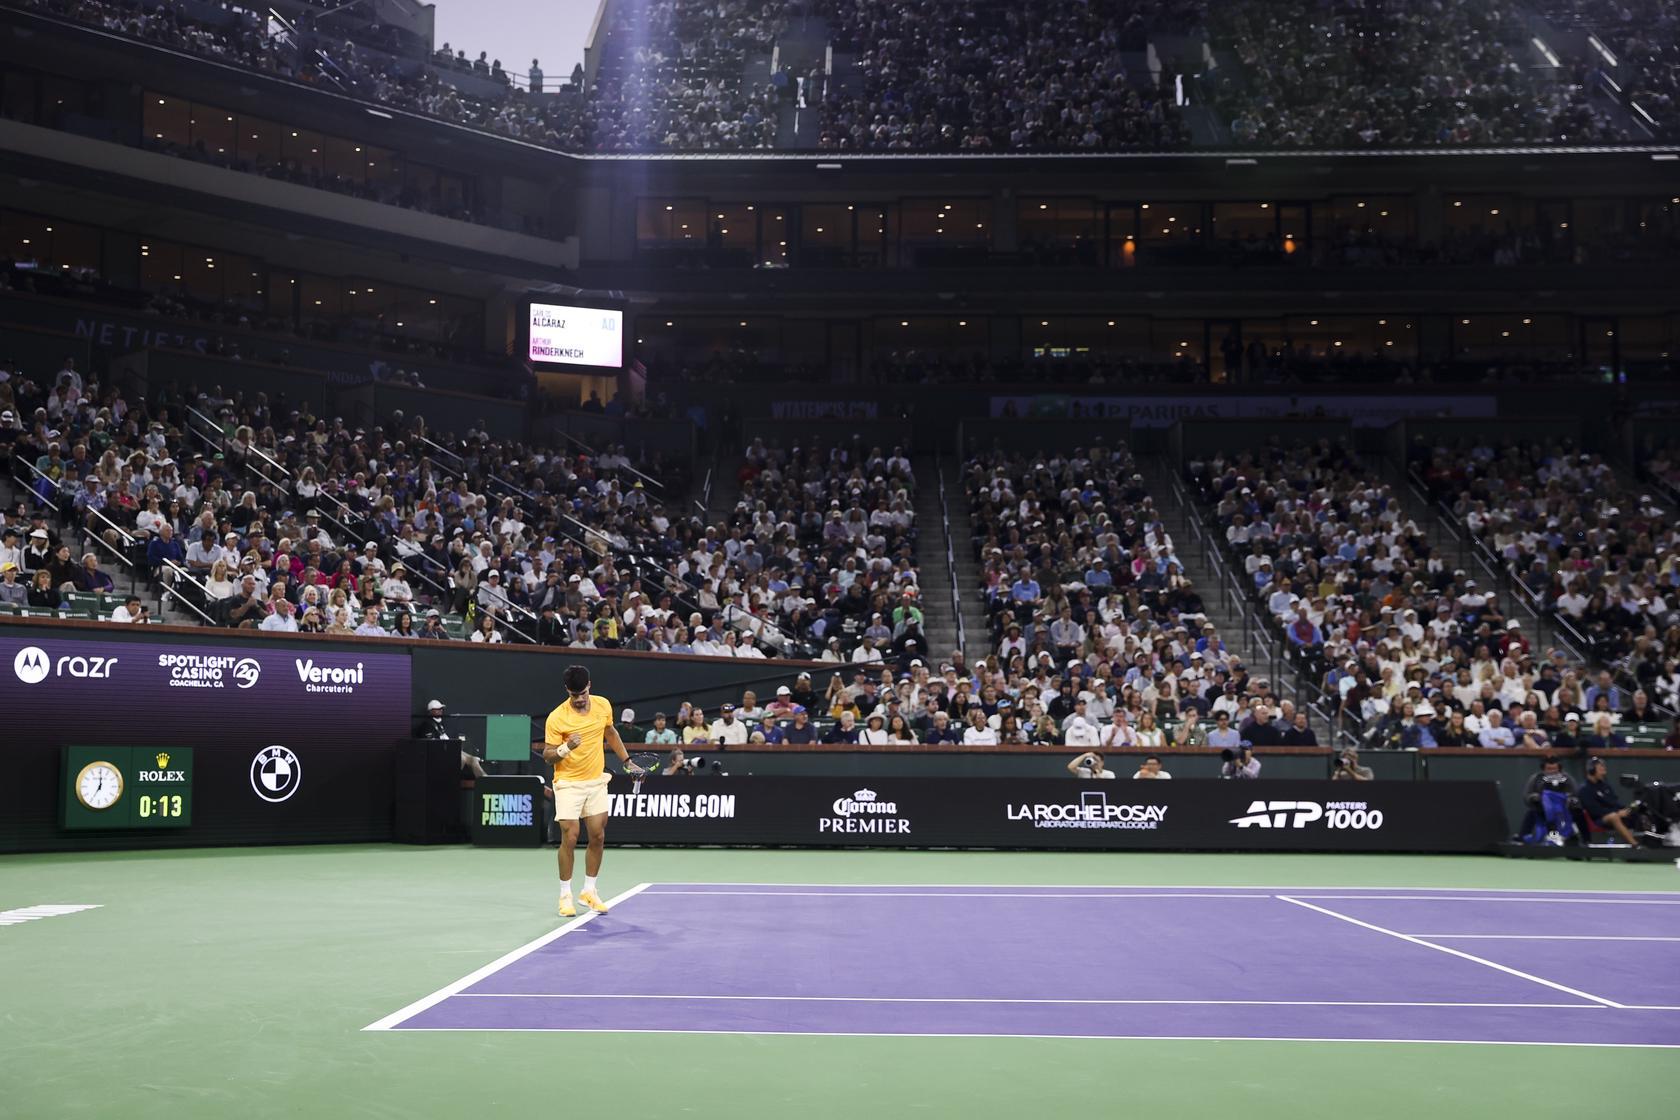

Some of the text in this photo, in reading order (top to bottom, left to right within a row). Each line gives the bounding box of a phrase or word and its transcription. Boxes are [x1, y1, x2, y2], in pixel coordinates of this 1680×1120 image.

[533, 318, 566, 329] ALCARAZ
[532, 346, 584, 359] RINDERKNECH
[1128, 404, 1219, 420] PARIBAS
[57, 656, 118, 678] razr
[159, 654, 236, 669] SPOTLIGHT
[171, 667, 223, 680] CASINO
[236, 664, 259, 689] 29
[296, 656, 363, 684] Veroni
[306, 684, 354, 694] Charcuterie
[139, 770, 185, 782] ROLEX
[140, 796, 182, 818] 0:13
[482, 794, 532, 811] TENNIS
[608, 794, 735, 818] TATENNIS.COM
[833, 798, 897, 817] Corona
[1326, 802, 1368, 811] MASTERS
[482, 812, 533, 826] PARADISE
[1229, 801, 1323, 828] ATP
[1325, 810, 1384, 829] 1000
[820, 818, 911, 833] PREMIER
[1035, 820, 1157, 829] LABORATOIRE DERMATOLOGIQUE
